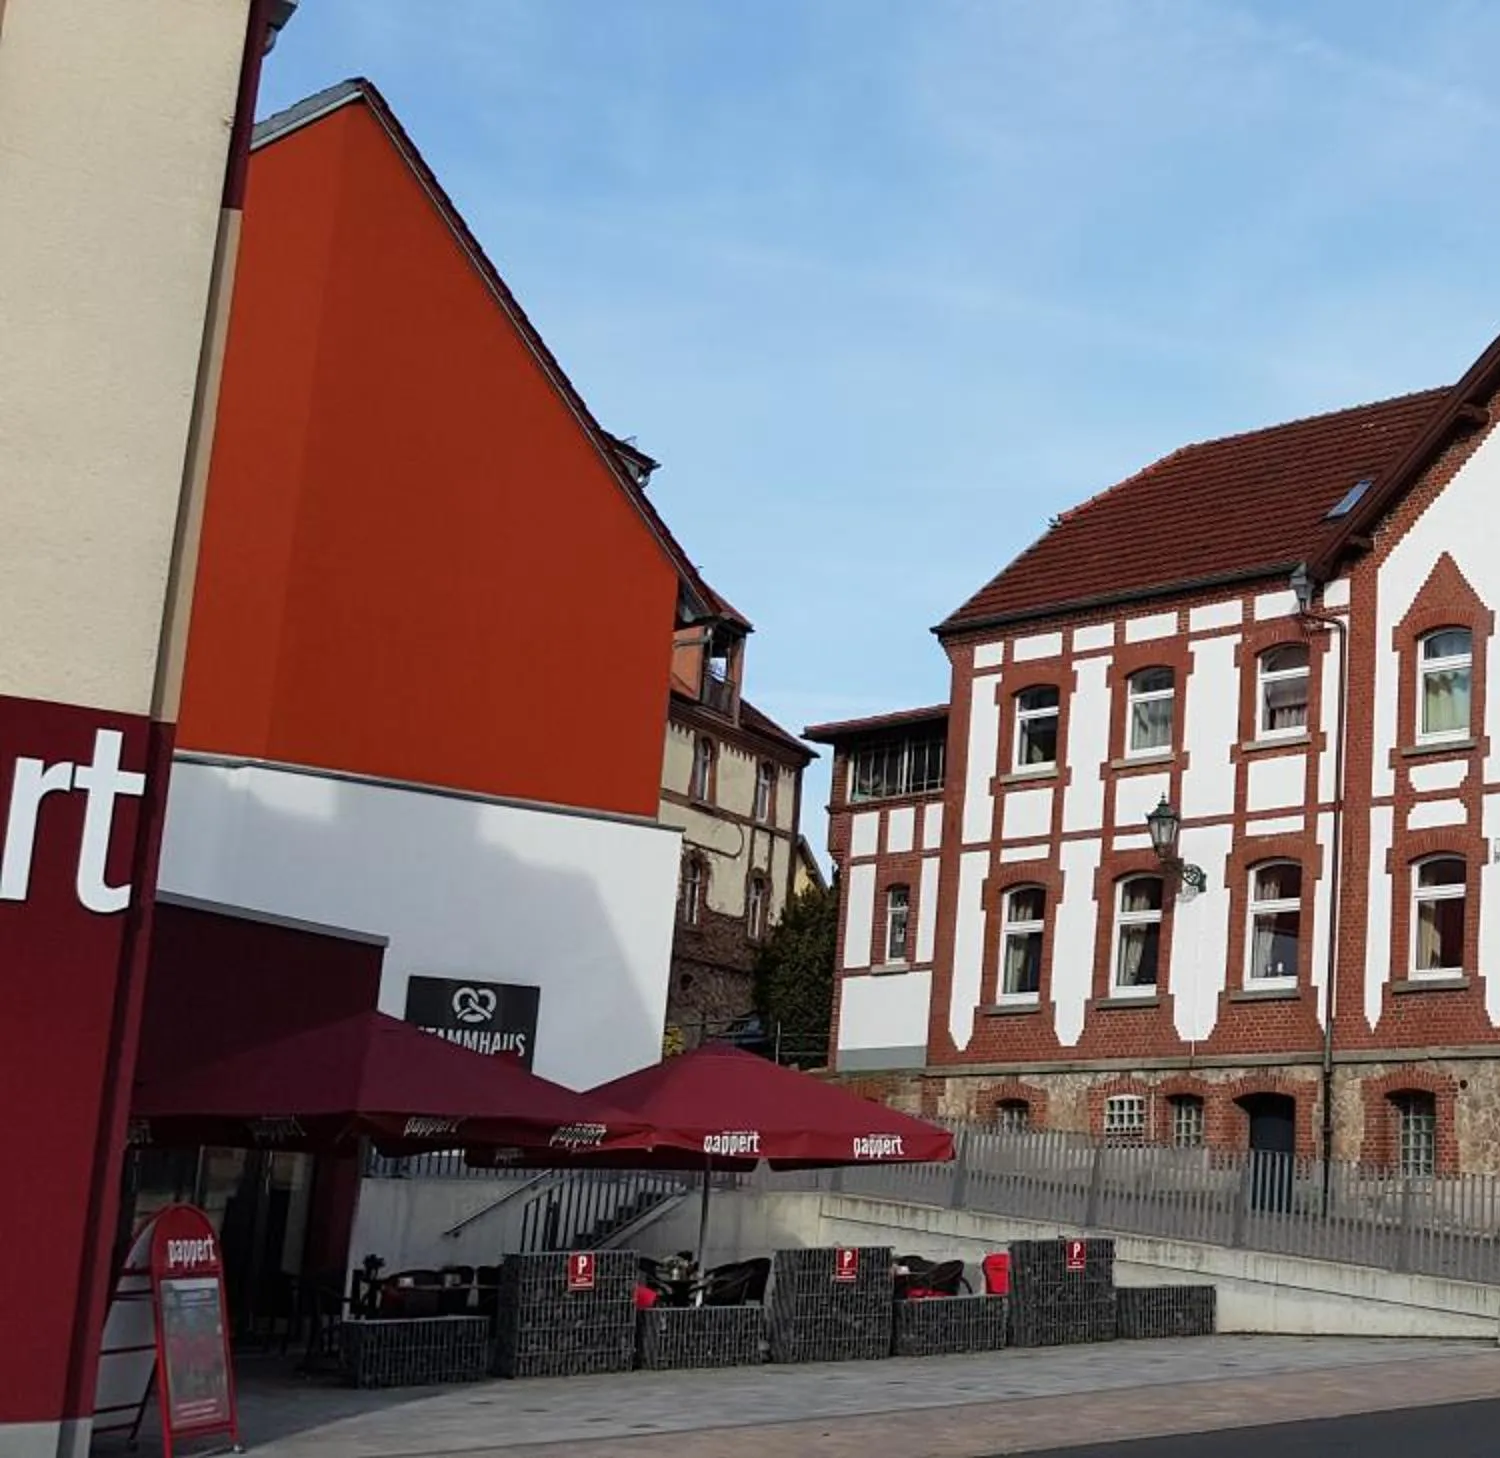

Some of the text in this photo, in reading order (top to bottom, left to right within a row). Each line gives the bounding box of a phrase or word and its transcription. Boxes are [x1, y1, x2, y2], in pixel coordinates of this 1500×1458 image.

[0, 728, 146, 913] rt
[703, 1132, 760, 1155] pappert
[853, 1135, 904, 1158] pappert
[167, 1233, 216, 1269] pappert
[843, 1251, 853, 1268] P
[1073, 1242, 1081, 1259] P
[577, 1255, 587, 1275] P
